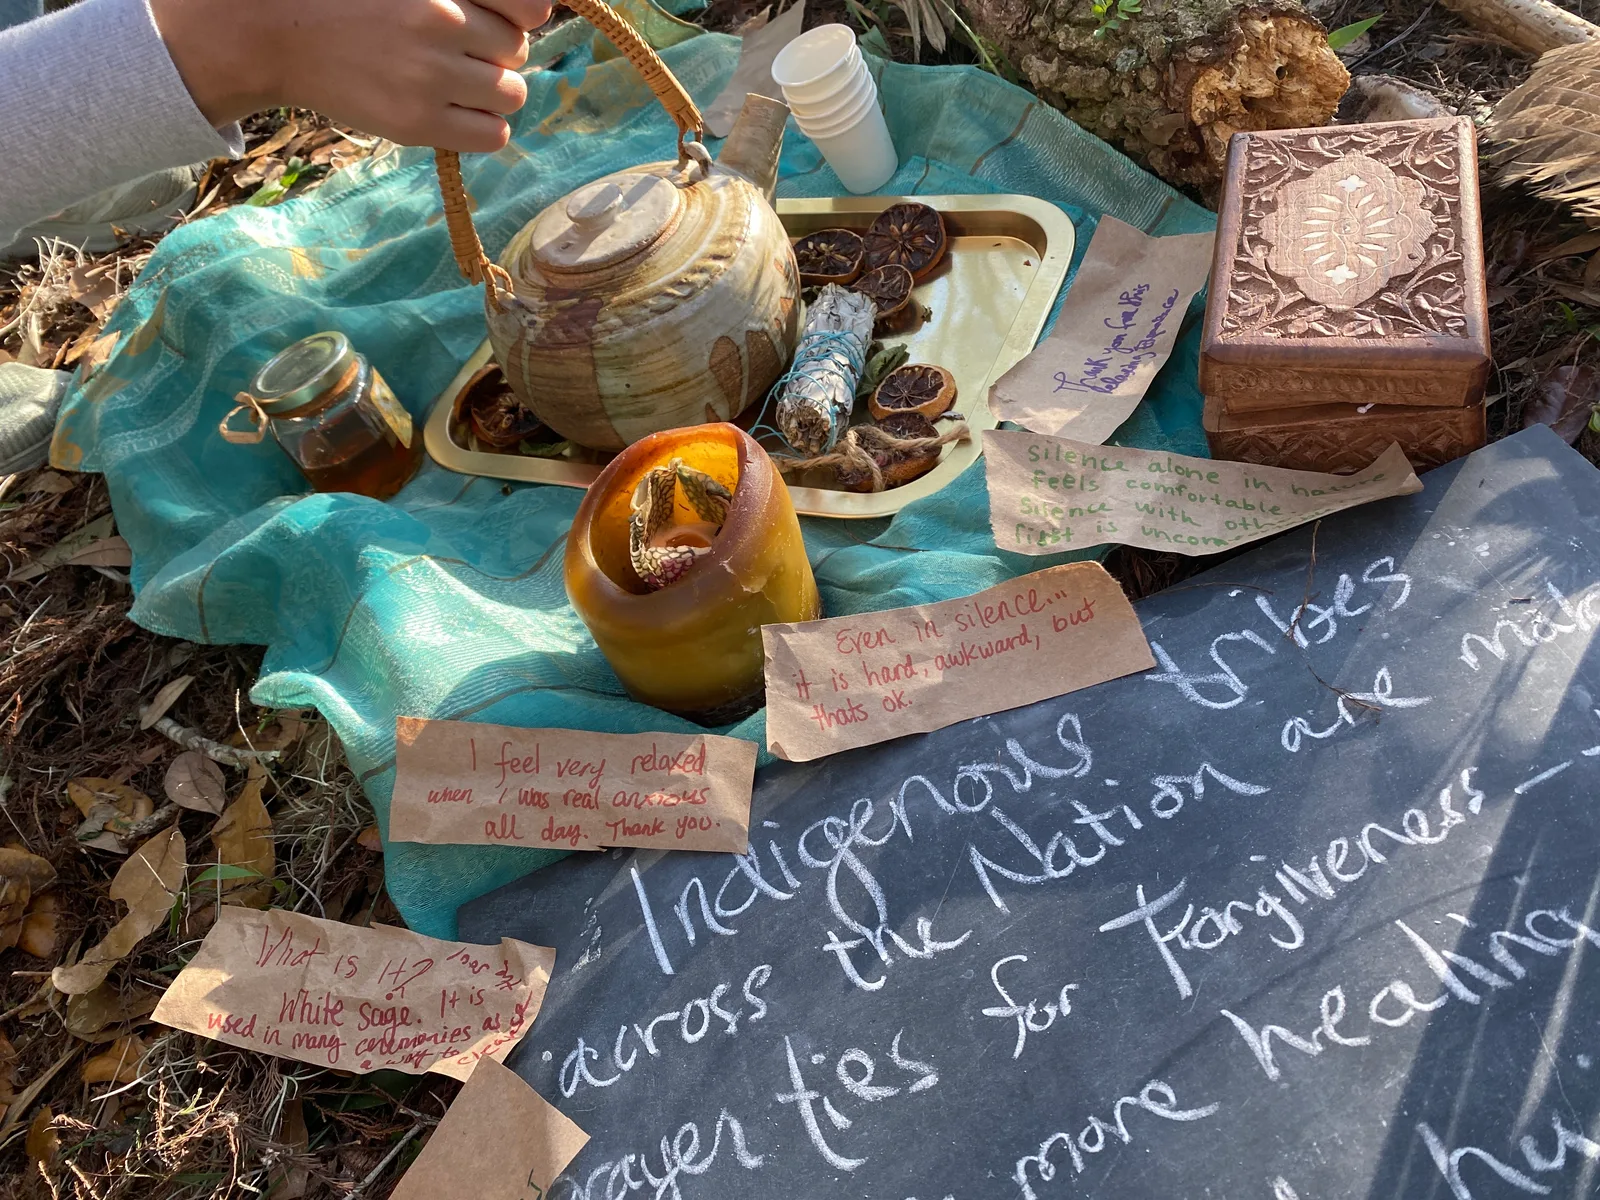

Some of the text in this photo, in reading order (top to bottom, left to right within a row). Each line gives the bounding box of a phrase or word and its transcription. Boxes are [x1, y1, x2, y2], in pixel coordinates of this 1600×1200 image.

[1148, 457, 1220, 484] alone
[1243, 472, 1273, 493] in
[1097, 521, 1119, 533] is
[1135, 501, 1202, 527] with
[795, 598, 1097, 699] it is hard, awkward, but
[836, 629, 896, 655] Even
[915, 620, 943, 643] in
[810, 699, 869, 731] thats
[470, 738, 707, 788] I feel very relaxed
[630, 556, 1413, 975] Indigenous tribes
[427, 787, 473, 804] when
[518, 787, 550, 810] was
[563, 785, 600, 811] real
[612, 786, 711, 810] anxious
[484, 815, 720, 847] all day. Thank you.
[558, 963, 772, 1098] across
[822, 916, 973, 992] the
[968, 762, 1270, 914] Nation
[1281, 666, 1432, 753] are
[256, 924, 325, 969] What
[278, 989, 345, 1029] White
[469, 986, 485, 1005] is
[208, 1012, 501, 1065] used in many ceremonies as
[440, 1046, 460, 1059] to
[547, 1107, 765, 1200] rayer
[774, 1028, 940, 1172] ties
[981, 954, 1080, 1060] for
[1011, 1079, 1221, 1200] more
